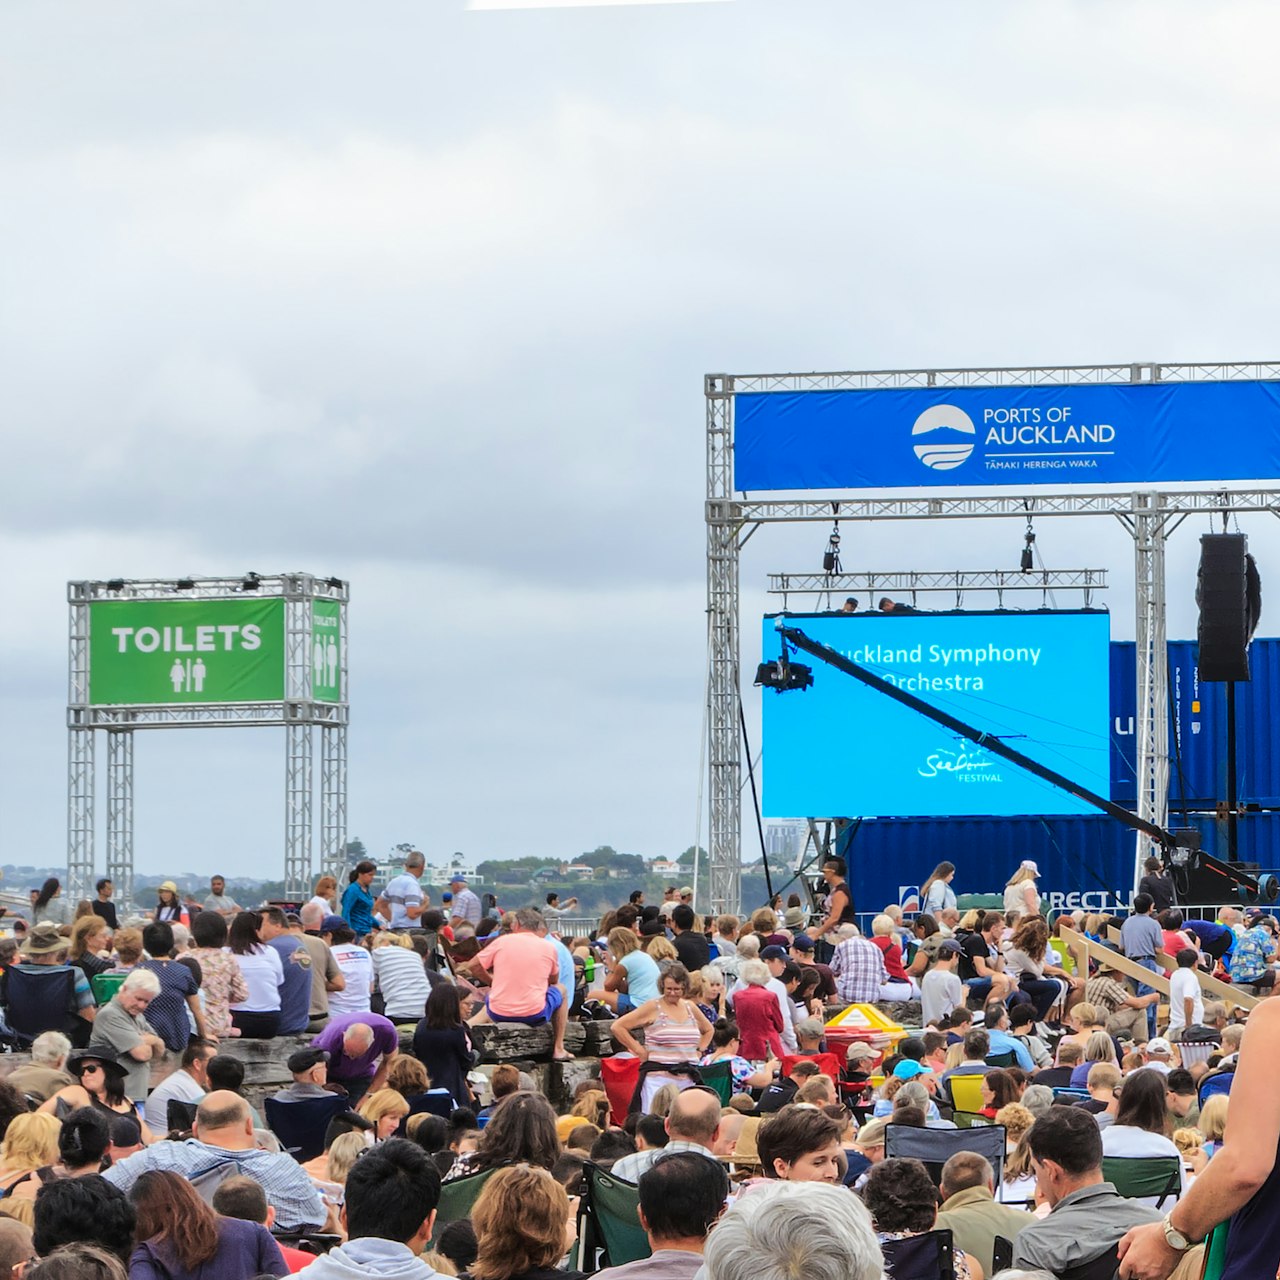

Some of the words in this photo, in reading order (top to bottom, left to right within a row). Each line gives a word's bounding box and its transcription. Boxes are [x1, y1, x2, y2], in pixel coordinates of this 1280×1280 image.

[984, 407, 1041, 424] PORTS
[1046, 406, 1072, 423] OF
[985, 424, 1116, 446] AUCKLAND
[984, 457, 1020, 470] TĀMAKI
[1023, 460, 1067, 470] HERENGA
[1068, 459, 1098, 469] WAKA
[112, 623, 262, 653] TOILETS
[842, 643, 922, 663] uckland
[928, 643, 1041, 668] Symphony
[958, 773, 1003, 783] FESTIVAL
[1041, 890, 1111, 908] IRECT
